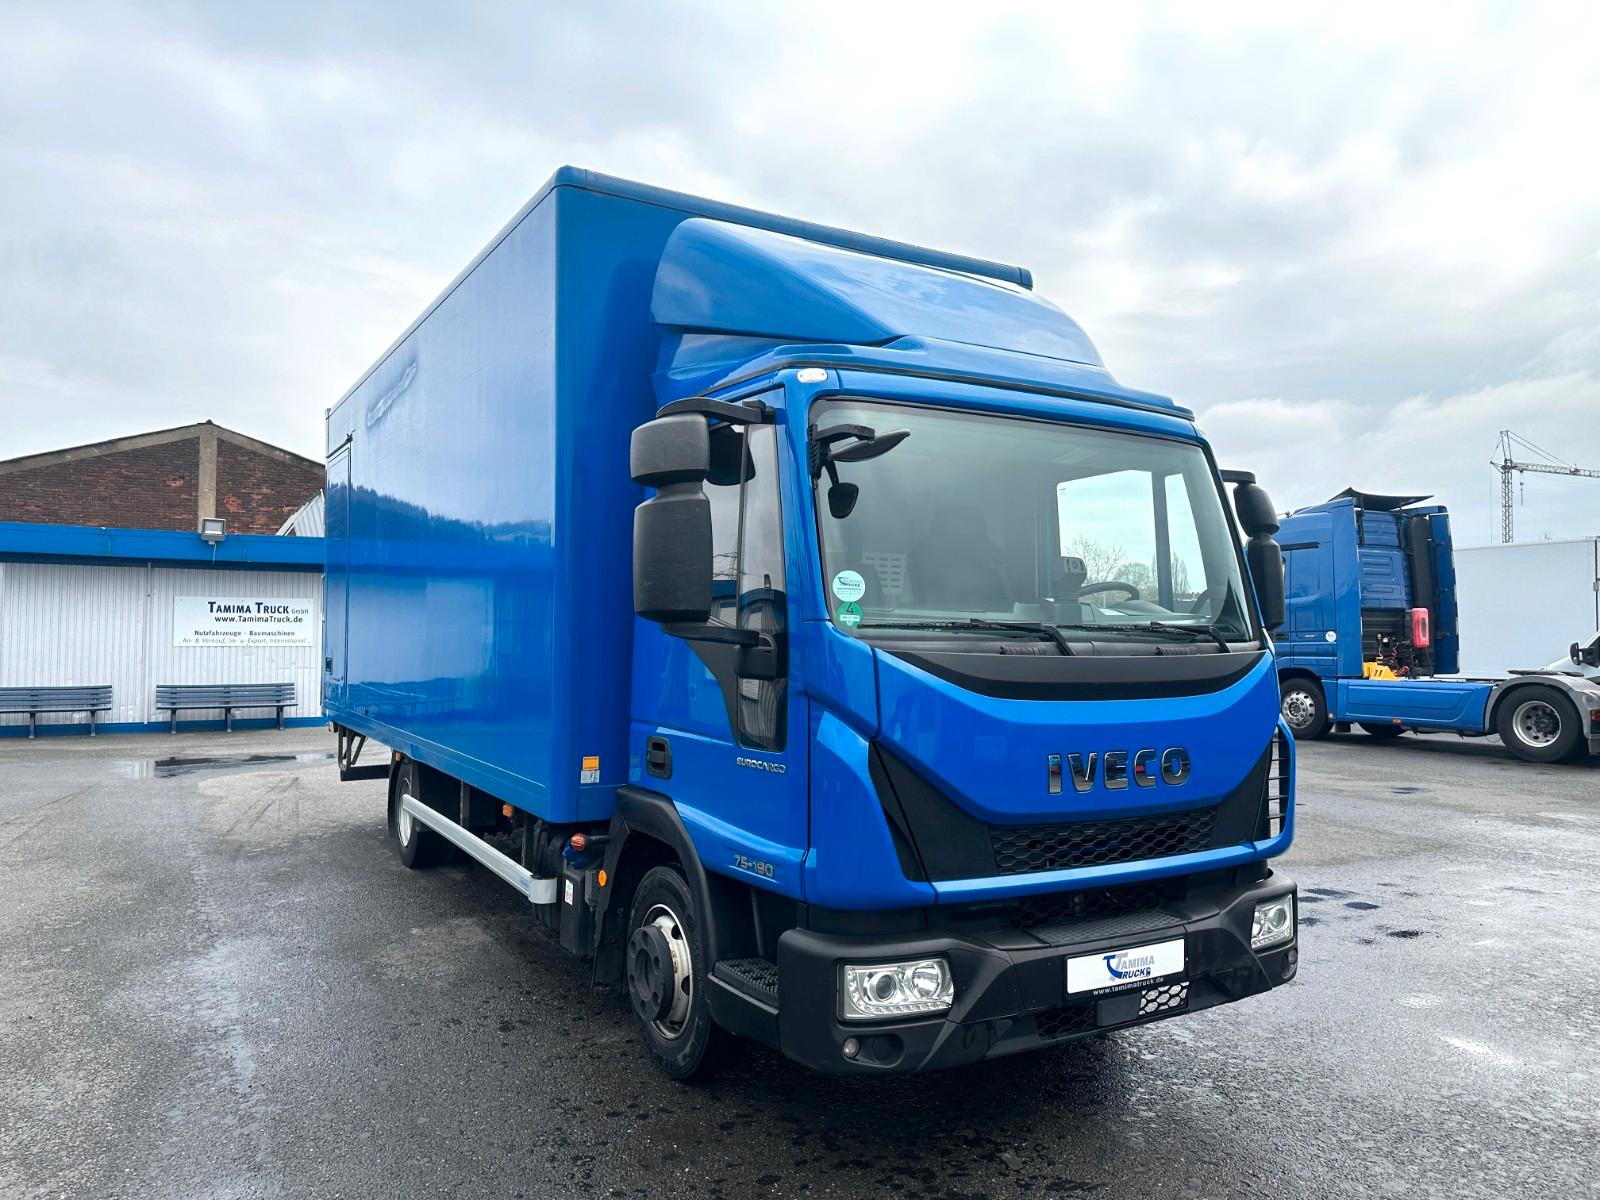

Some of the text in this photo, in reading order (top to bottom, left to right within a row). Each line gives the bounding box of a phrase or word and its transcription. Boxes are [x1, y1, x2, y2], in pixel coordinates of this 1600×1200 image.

[208, 601, 252, 614] TAMIMA
[255, 602, 289, 614] TRUCK
[846, 602, 854, 615] 4
[214, 615, 304, 623] www.TamimaTruck.de
[736, 757, 786, 773] EUROCARGO
[1048, 747, 1191, 795] IVECO
[1115, 952, 1155, 970] TAMIMA
[1092, 976, 1164, 995] www.tamimatruck.de
